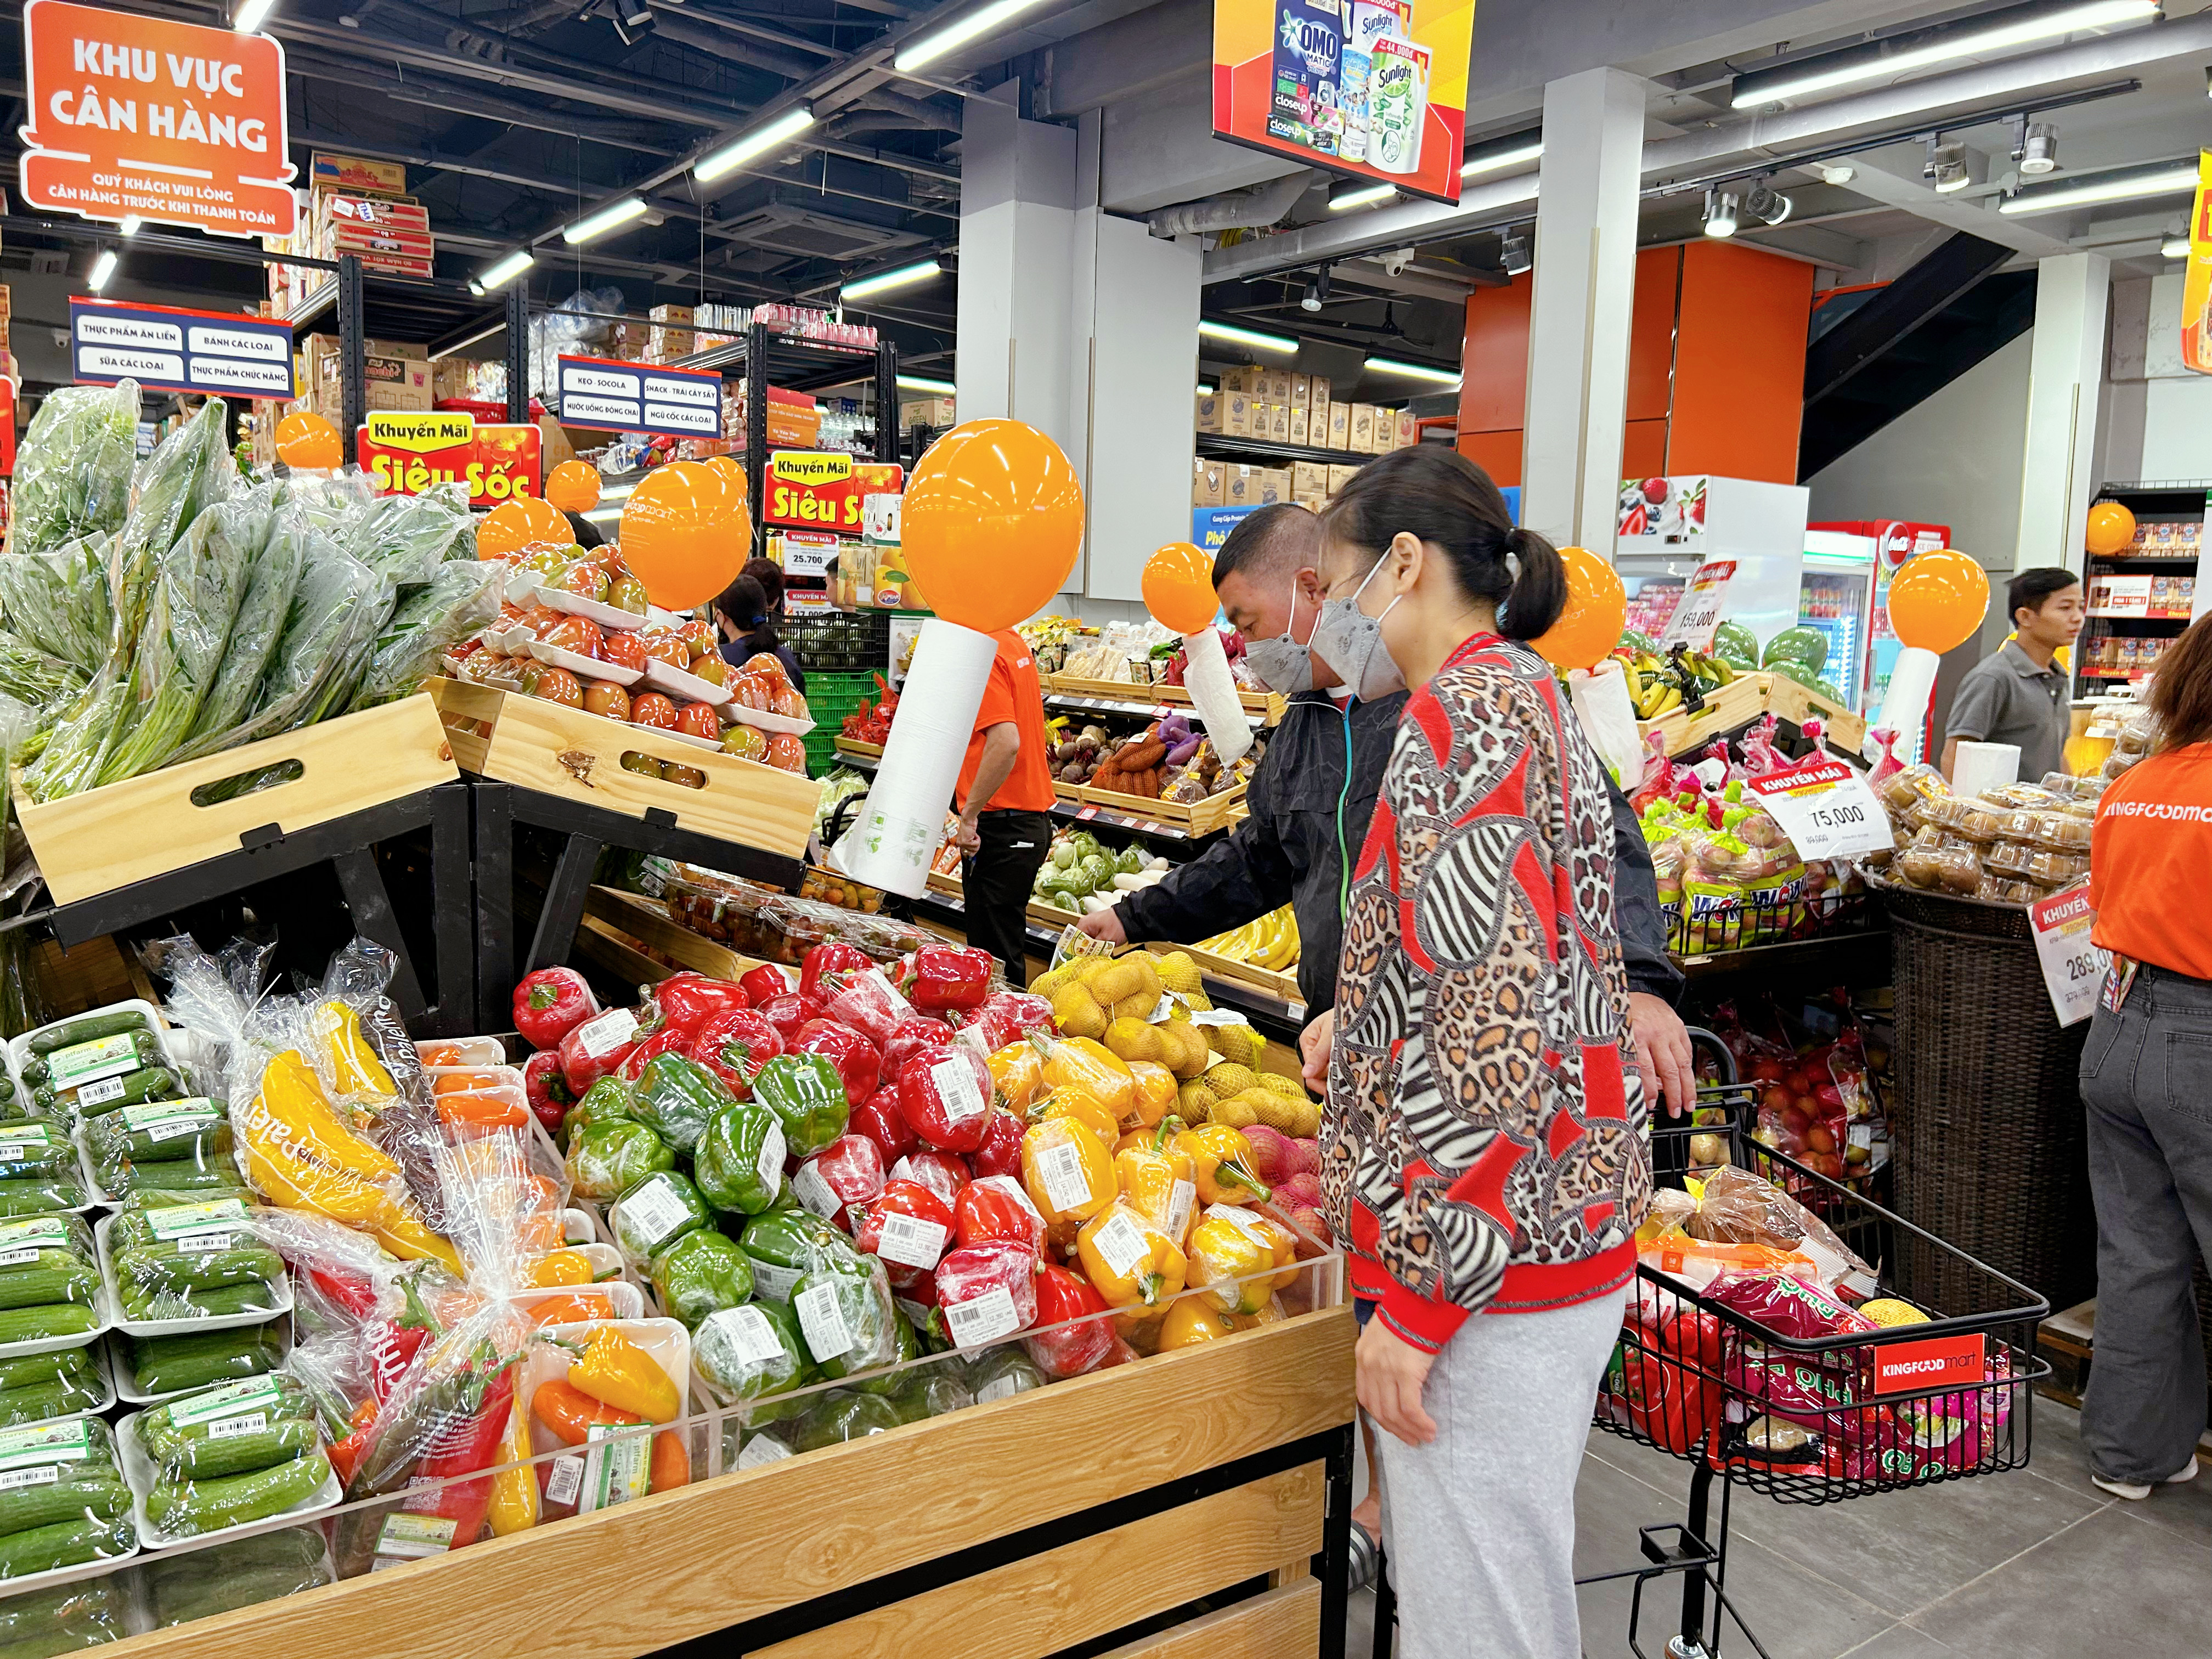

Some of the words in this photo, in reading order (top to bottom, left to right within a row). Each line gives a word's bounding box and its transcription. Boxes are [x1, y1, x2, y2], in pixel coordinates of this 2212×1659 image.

[1362, 14, 1392, 34] Sunlight
[1301, 24, 1337, 60] OMO
[74, 38, 156, 83] KHU
[166, 53, 244, 99] VỰC
[1307, 53, 1330, 67] MATIC
[1379, 65, 1412, 88] Sunlight
[1275, 94, 1307, 115] closeup
[50, 85, 137, 133] CÂN
[149, 100, 267, 153] HÀNG
[1270, 119, 1301, 139] closeup
[92, 172, 122, 190] QUÝ
[125, 174, 170, 193] KHÁCH
[172, 184, 194, 198] VUI
[196, 182, 234, 203] LÒNG
[48, 184, 78, 200] CÂN
[80, 187, 120, 208] HÀNG
[122, 191, 166, 211] TRƯỚC
[168, 200, 190, 214] KHI
[192, 202, 237, 220] THANH
[239, 207, 275, 225] TOÁN
[83, 324, 108, 337] THỰC
[110, 324, 138, 337] PHẨM
[140, 328, 155, 340] ĂN
[157, 330, 176, 341] LIỀN
[204, 334, 229, 348] BÁNH
[232, 337, 249, 349] CÁC
[251, 342, 273, 353] LOẠI
[99, 354, 117, 366] SỮA
[120, 356, 139, 368] CÁC
[140, 360, 163, 371] LOẠI
[192, 365, 213, 377] THỰC
[215, 365, 239, 378] PHẨM
[240, 367, 261, 380] CHỨC
[262, 370, 286, 382] NĂNG
[578, 377, 592, 387] KẸO
[597, 380, 626, 389] SOCOLA
[646, 385, 667, 394] SNACK
[673, 386, 687, 396] TRÁI
[689, 388, 702, 398] CÂY
[703, 390, 715, 399] SẤY
[567, 402, 584, 411] NƯỚC
[585, 404, 604, 413] UỐNG
[605, 405, 623, 415] ĐÓNG
[624, 408, 639, 416] CHAI
[651, 410, 665, 419] NGŨ
[666, 411, 680, 421] CỐC
[681, 413, 694, 422] CÁC
[695, 416, 711, 425] LOẠI
[909, 415, 927, 425] GREEN
[375, 421, 436, 441] Khuyến
[440, 422, 468, 438] Mãi
[371, 455, 455, 494] Siêu
[466, 461, 529, 500] Sốc
[778, 460, 823, 476] Khuyến
[827, 461, 848, 474] Mãi
[774, 487, 837, 522] Siêu
[792, 533, 819, 542] KHUYẾN
[1205, 531, 1225, 546] Phô
[793, 555, 822, 564] 25.700
[1680, 611, 1715, 630] 159,000
[1760, 770, 1817, 792] KHUYẾN
[1815, 766, 1843, 781] MÃI
[1810, 805, 1864, 828] 75,000
[2066, 947, 2113, 981] 289,0
[65, 1047, 92, 1059] ptfarm
[167, 1207, 198, 1216] ptfarm
[1668, 1257, 1677, 1266] 50
[1883, 1351, 1977, 1377] KINGFOODmart
[0, 1430, 29, 1441] tfarm
[631, 1445, 641, 1474] ptfarm
